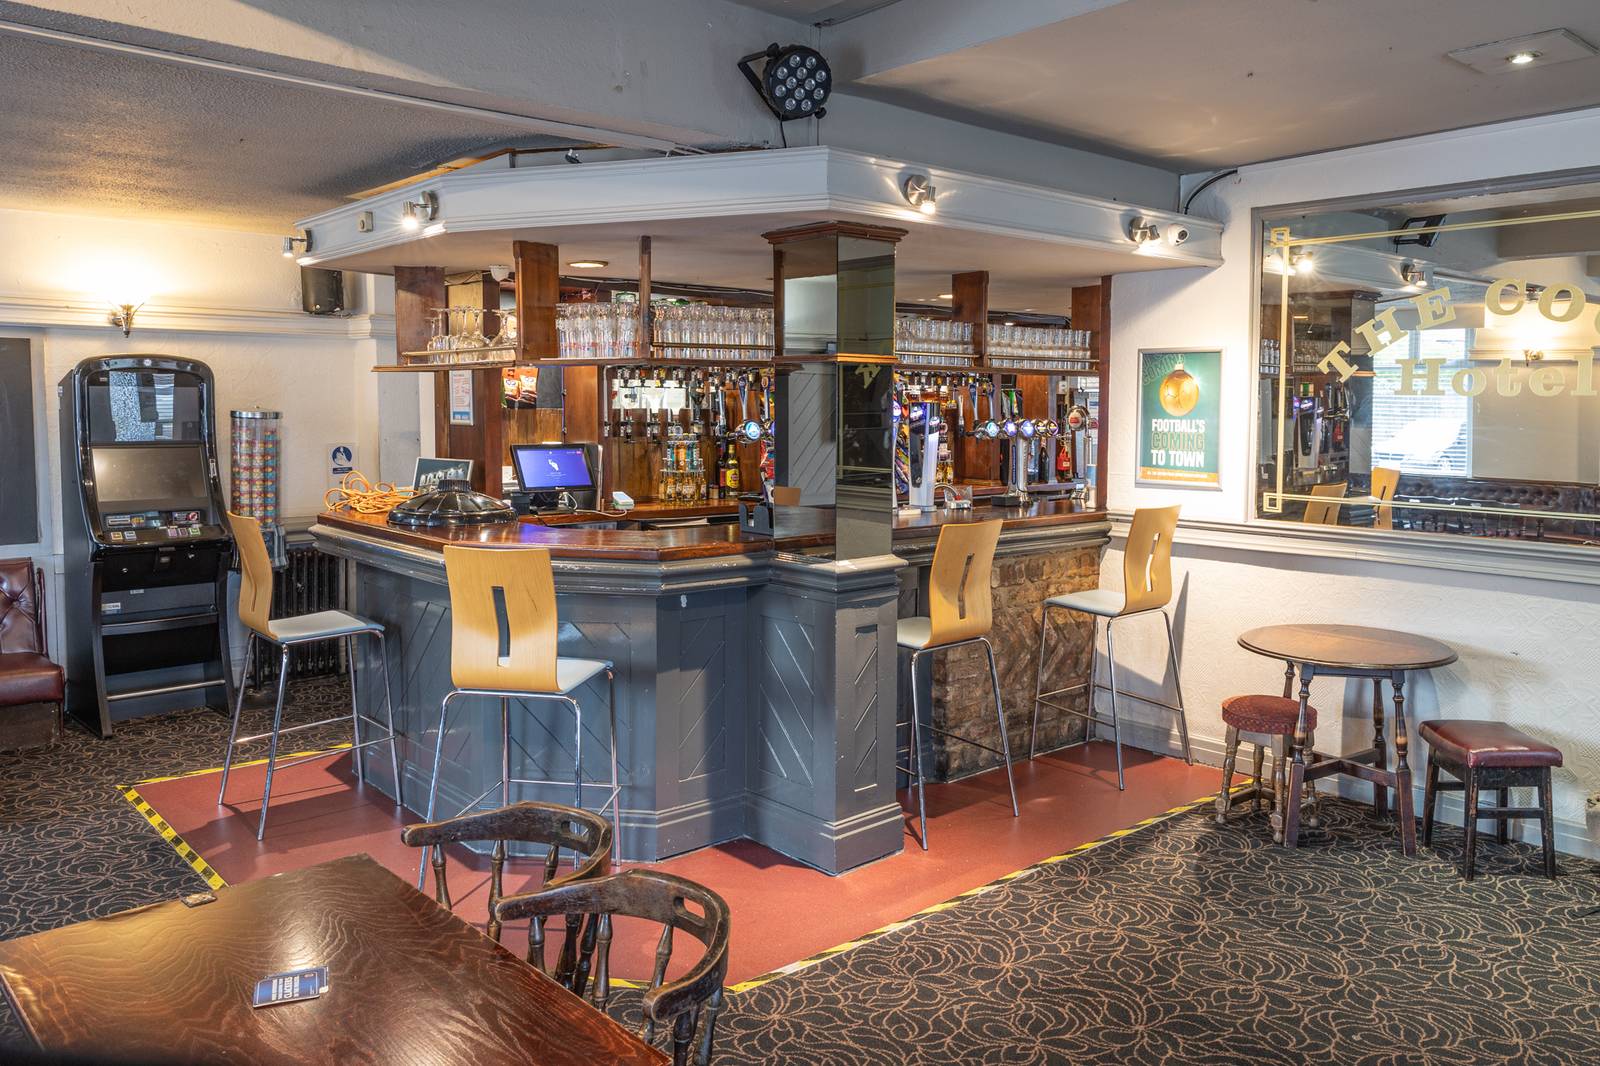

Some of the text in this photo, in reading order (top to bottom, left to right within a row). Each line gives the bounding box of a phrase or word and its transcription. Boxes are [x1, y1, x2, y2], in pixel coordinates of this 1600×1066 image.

[1316, 278, 1600, 384] THE CO
[1394, 350, 1598, 397] Hotel
[1151, 418, 1206, 433] FOOTBALL'S
[1151, 432, 1205, 451] COMING
[1151, 449, 1206, 468] TO TOWN
